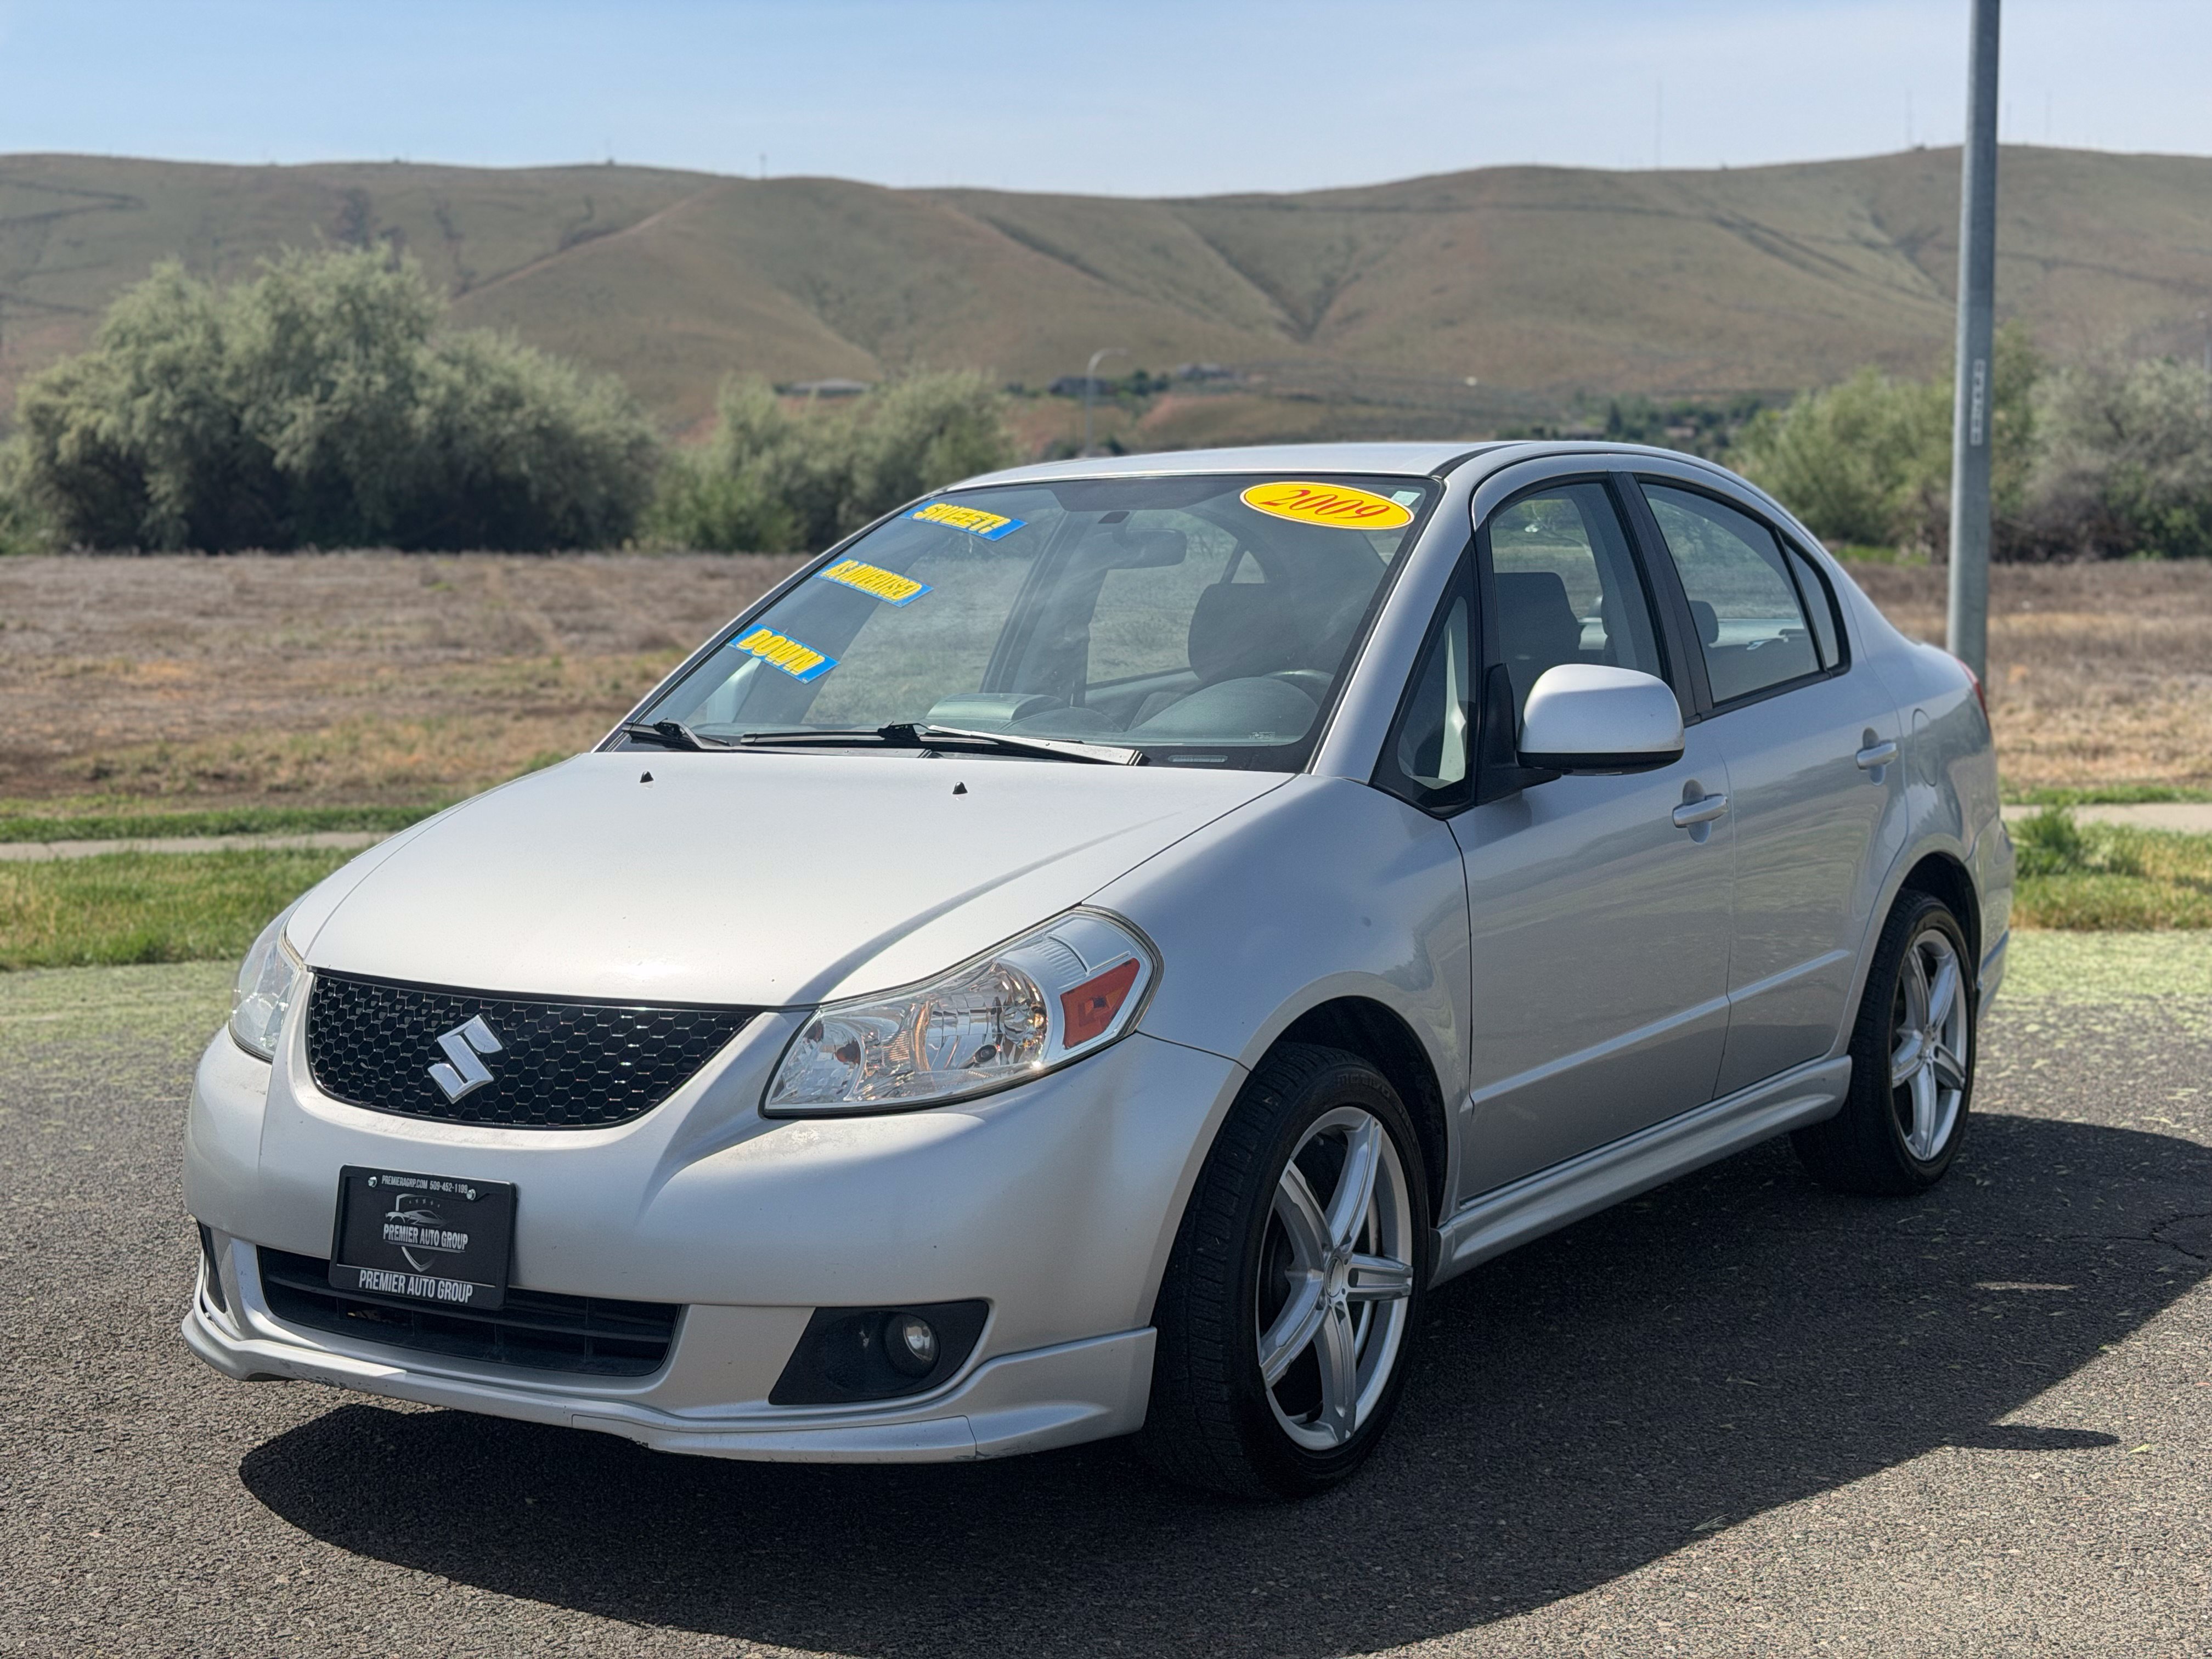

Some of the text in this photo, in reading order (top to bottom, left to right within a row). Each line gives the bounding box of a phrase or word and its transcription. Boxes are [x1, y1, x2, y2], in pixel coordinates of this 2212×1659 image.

[912, 503, 1012, 534] SWEET!
[1258, 489, 1391, 519] 2009
[834, 563, 922, 602] ADVERTISED
[736, 628, 825, 675] DOWN
[381, 1175, 468, 1194] PREMIERAGRP.COM 509-452-1199
[383, 1223, 468, 1250] PREMIER AUTO GROUP
[359, 1269, 473, 1304] PREMIER AUTO GROUP
